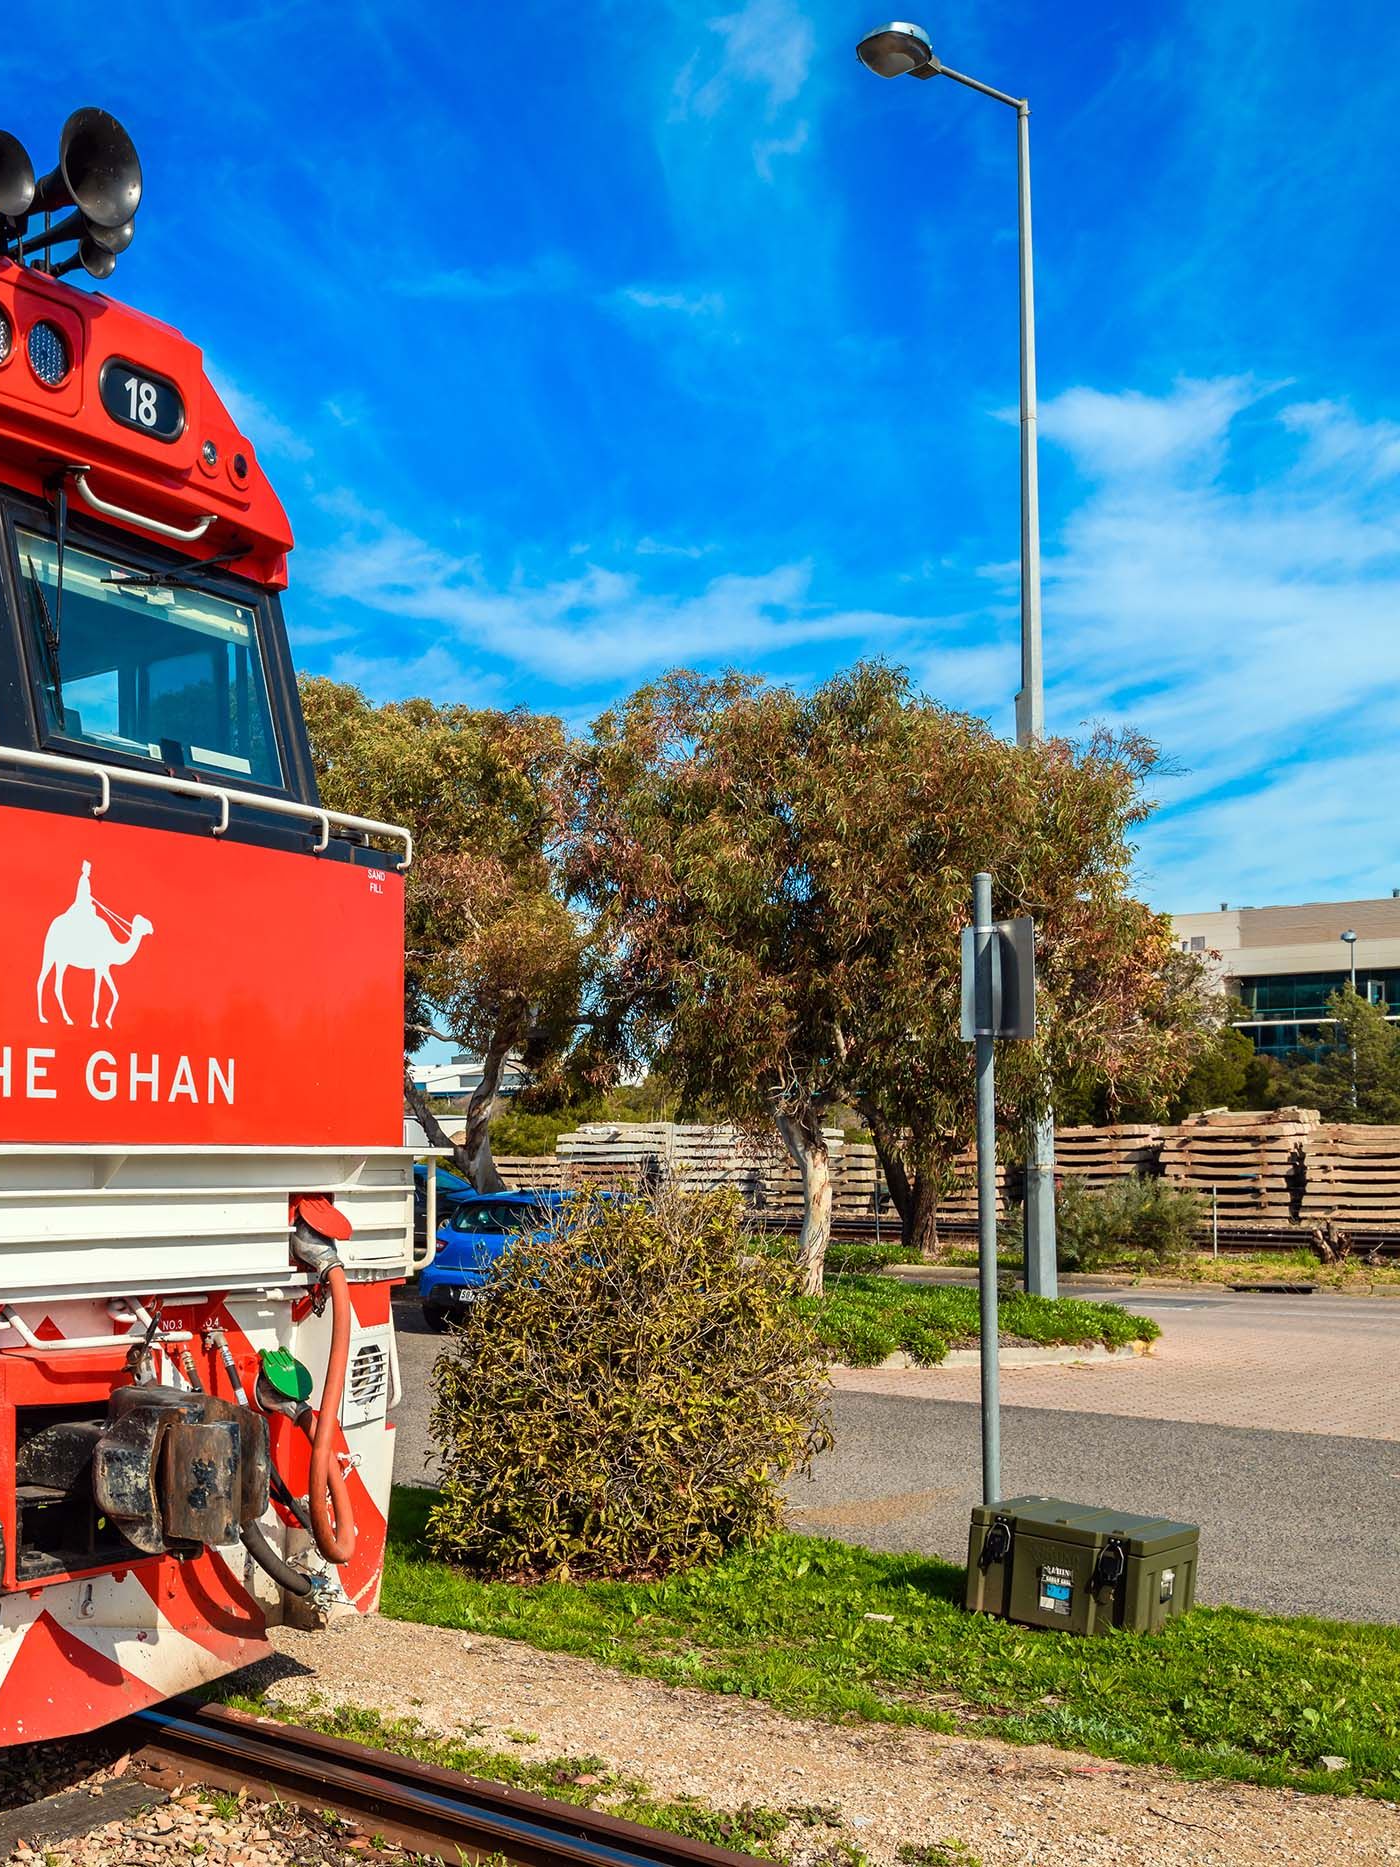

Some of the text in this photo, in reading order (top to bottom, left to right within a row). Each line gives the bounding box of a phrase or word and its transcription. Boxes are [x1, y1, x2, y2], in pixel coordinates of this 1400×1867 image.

[124, 377, 157, 427] 18
[367, 868, 386, 881] SAND
[369, 882, 384, 895] FILL
[85, 1050, 235, 1105] GHAN
[163, 1320, 183, 1330] NO.3
[202, 1316, 219, 1328] O.4
